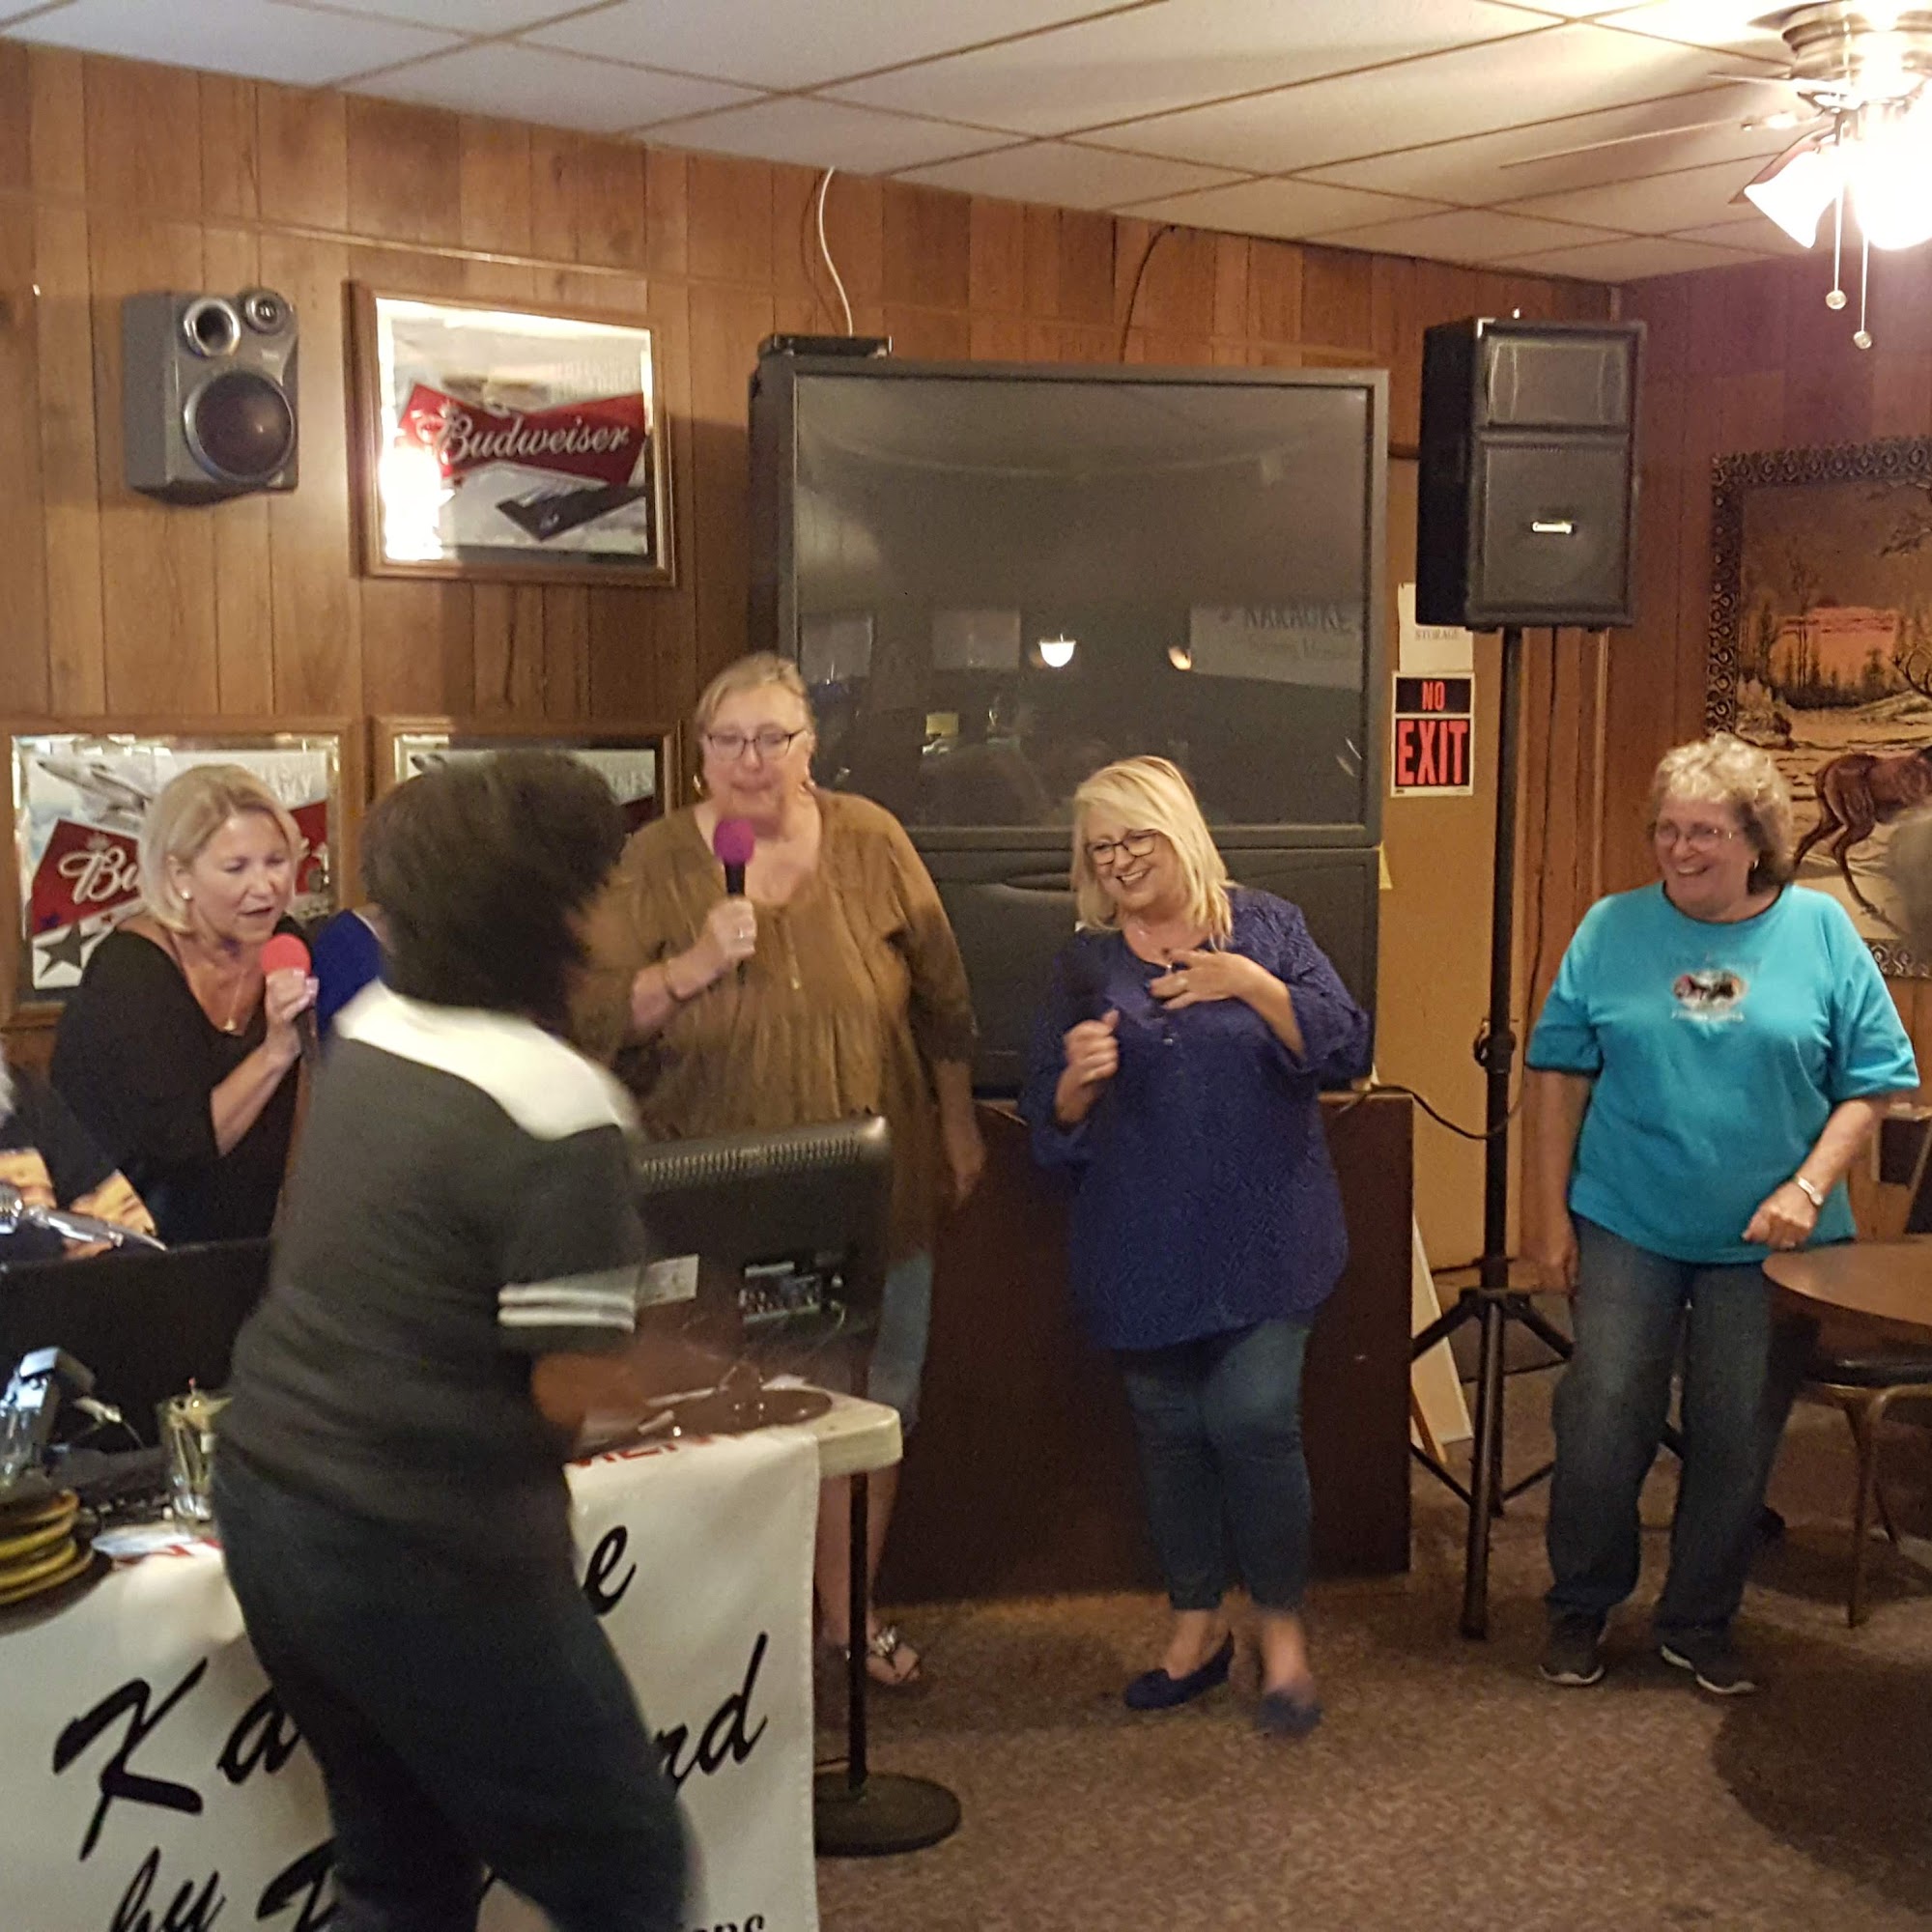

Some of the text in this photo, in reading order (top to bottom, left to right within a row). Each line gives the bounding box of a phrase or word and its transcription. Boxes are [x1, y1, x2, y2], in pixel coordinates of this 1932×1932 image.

[414, 412, 629, 463] Budweiser
[1421, 680, 1446, 711] NO
[1397, 720, 1468, 785] EXIT
